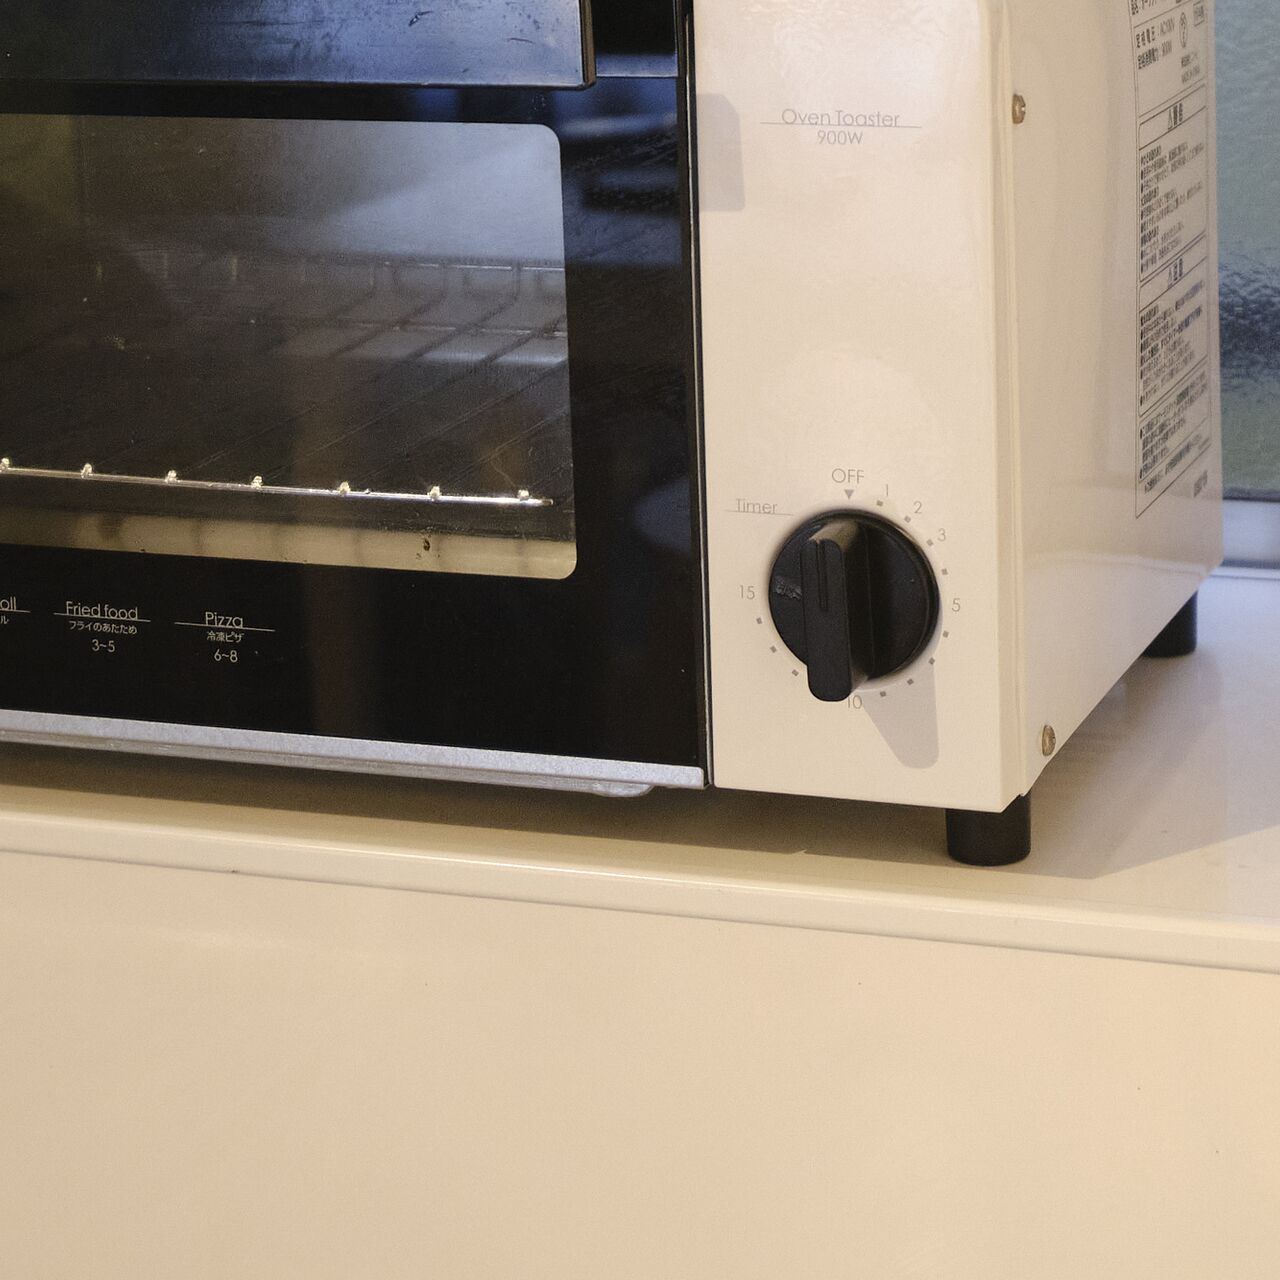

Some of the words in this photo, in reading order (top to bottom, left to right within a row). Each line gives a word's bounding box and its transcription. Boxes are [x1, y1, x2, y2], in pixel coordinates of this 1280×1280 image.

[781, 108, 831, 126] Oven
[834, 110, 900, 128] Toaster
[817, 130, 863, 145] 900W
[831, 468, 865, 484] OFF
[735, 498, 778, 515] Timer
[914, 501, 923, 514] 2
[937, 528, 947, 542] 3
[739, 584, 756, 599] 15
[66, 601, 101, 618] Fried
[102, 604, 139, 621] food
[951, 598, 961, 612] 5
[69, 620, 138, 635] フライのあたため
[205, 611, 244, 629] Pizza
[206, 630, 244, 643] 冷凍ピザ
[846, 695, 863, 710] 10
